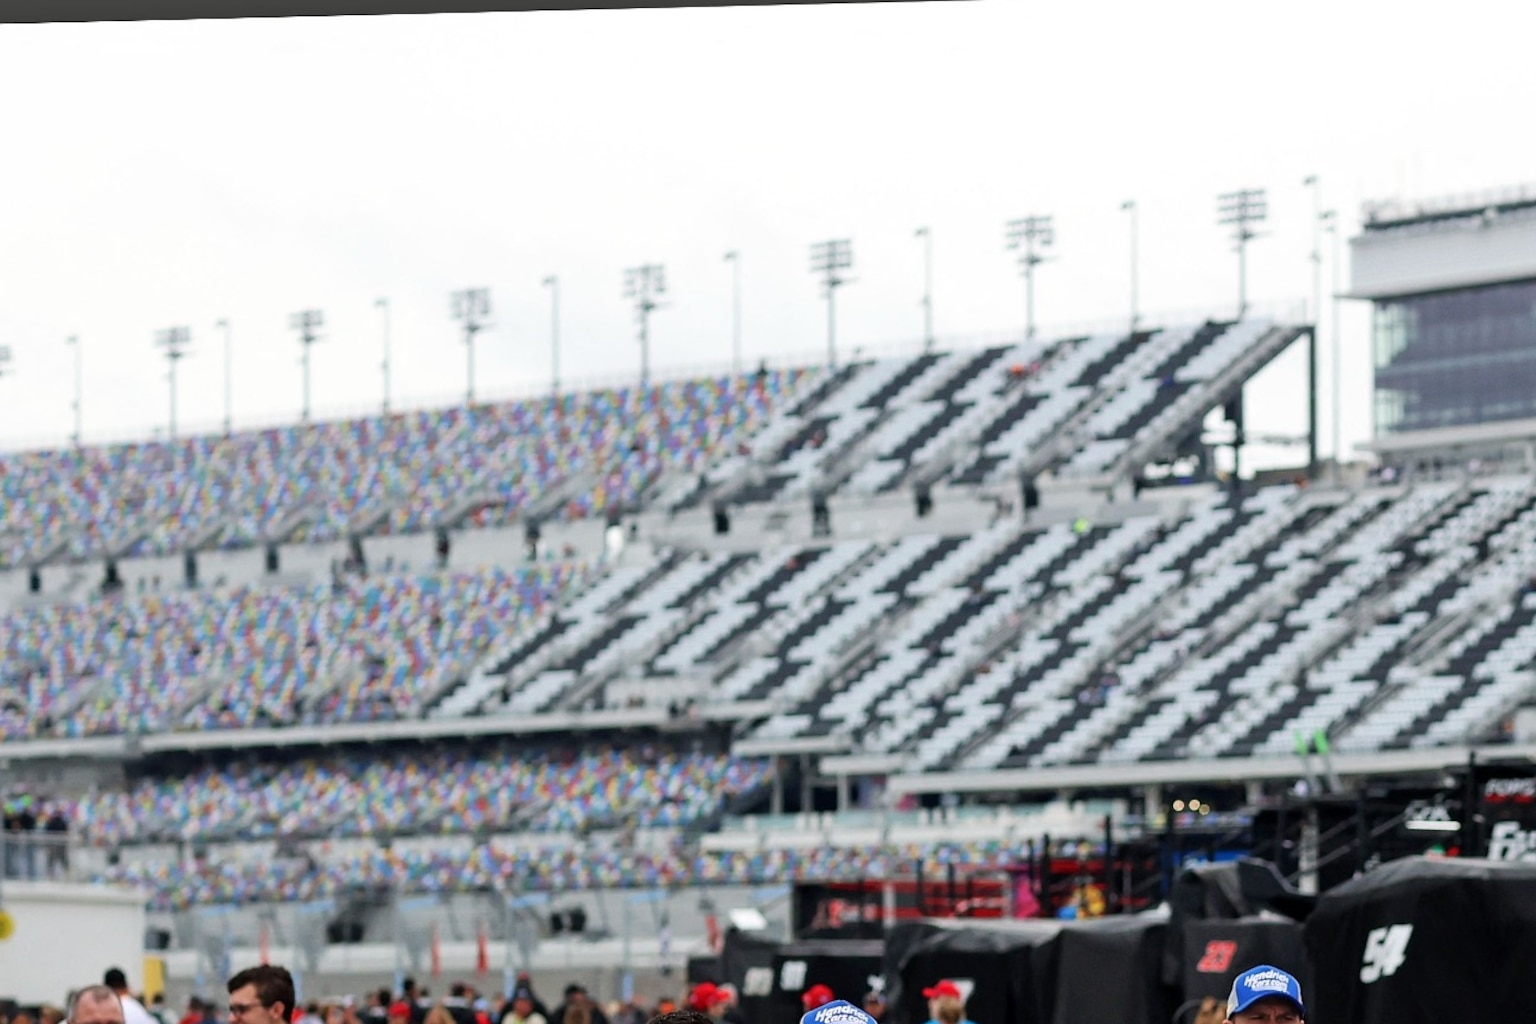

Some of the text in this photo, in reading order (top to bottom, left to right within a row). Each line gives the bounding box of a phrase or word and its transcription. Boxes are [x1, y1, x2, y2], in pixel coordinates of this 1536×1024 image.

[1359, 923, 1414, 984] 54
[1243, 969, 1290, 988] Hendrick
[814, 1004, 869, 1023] Hendrick
